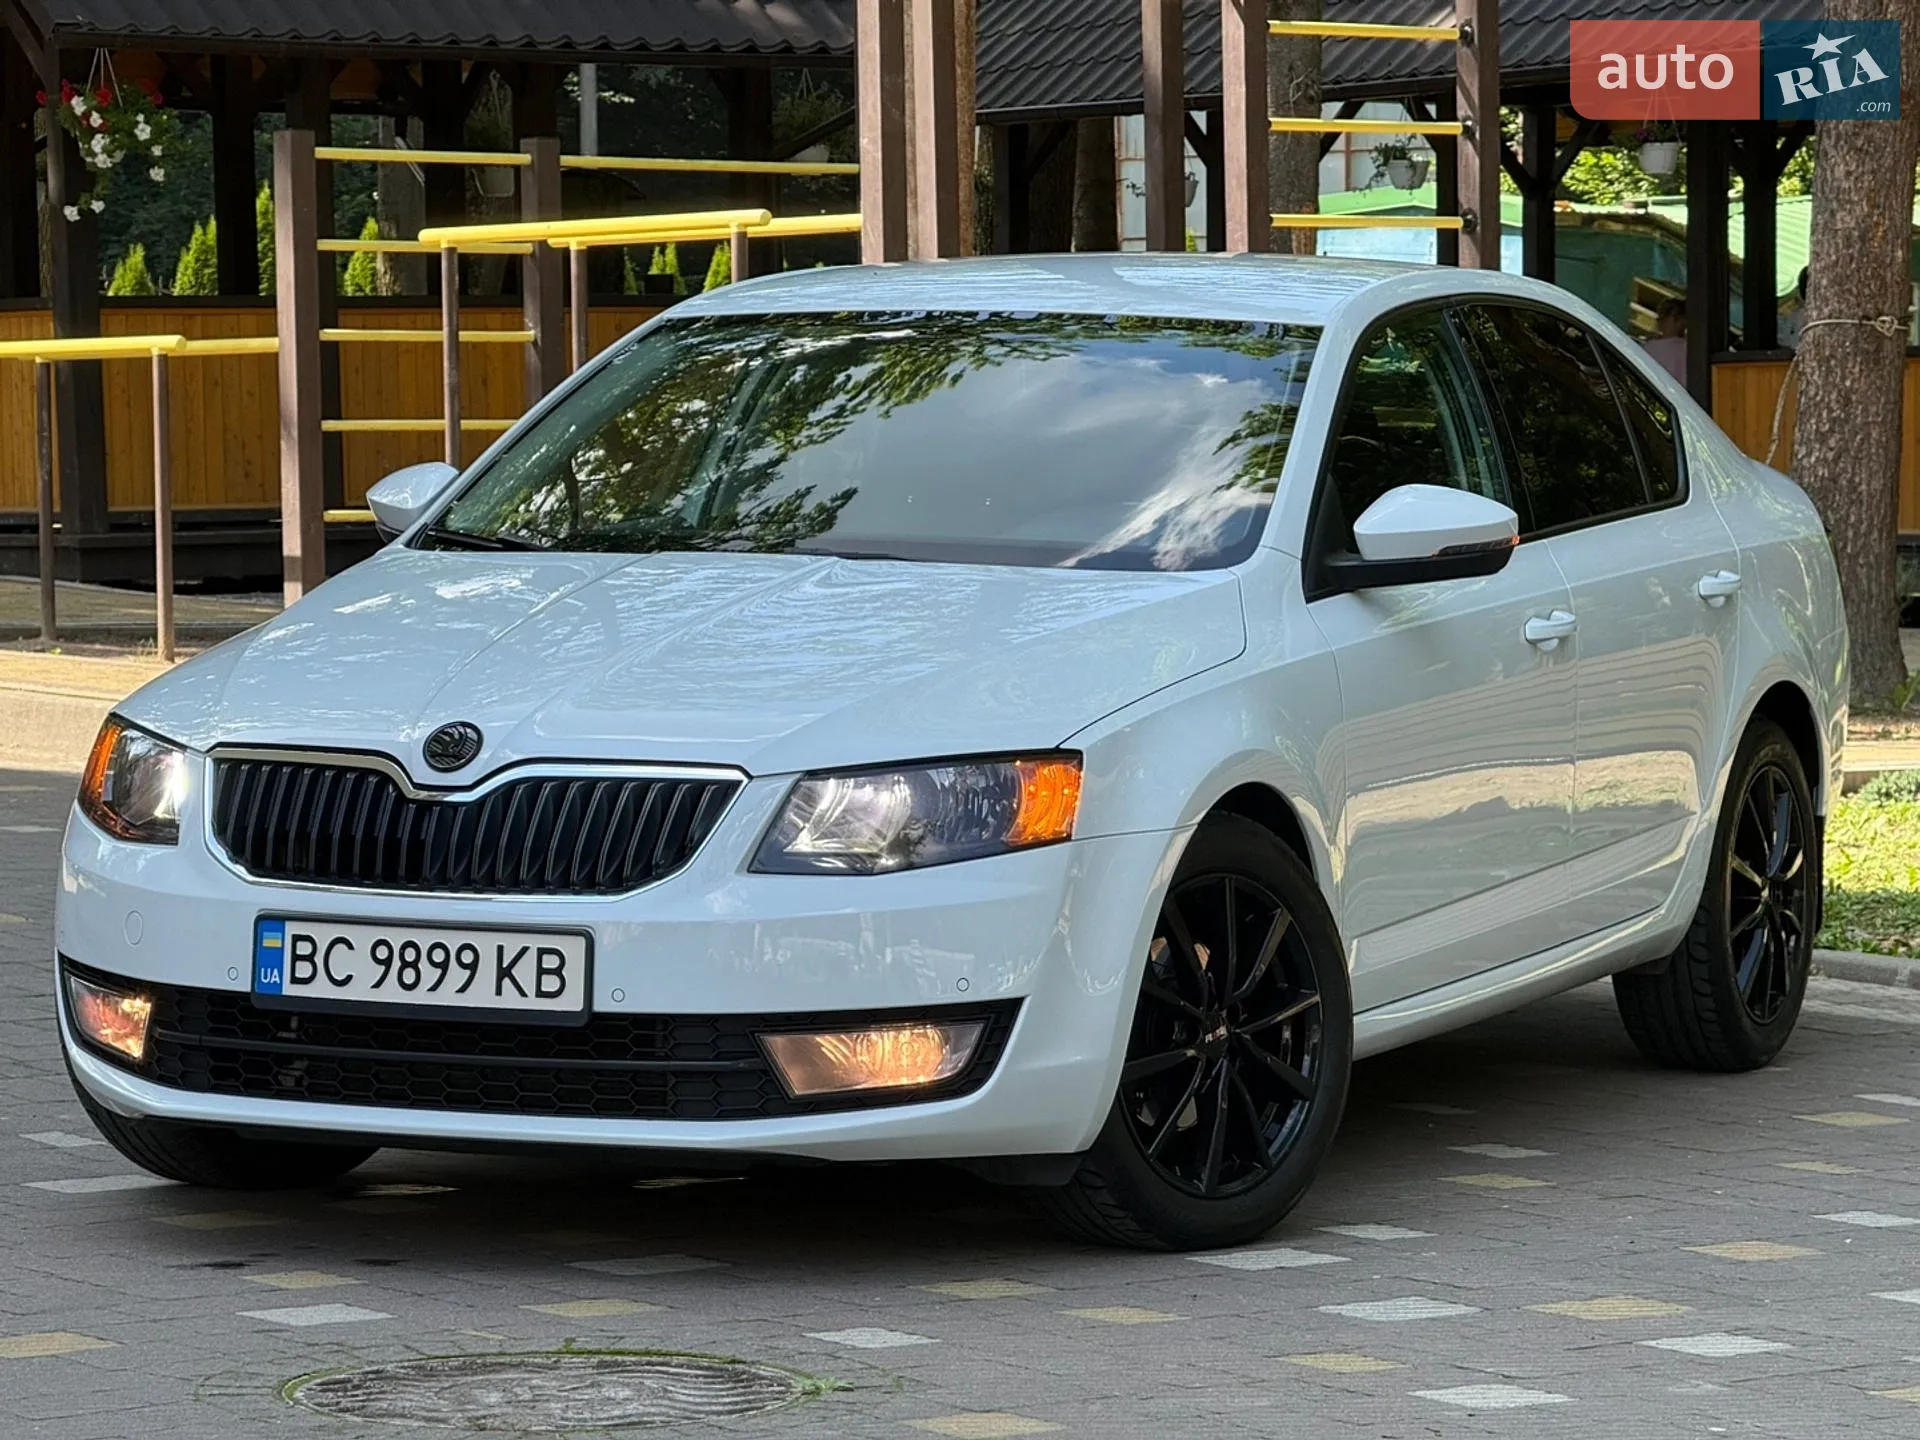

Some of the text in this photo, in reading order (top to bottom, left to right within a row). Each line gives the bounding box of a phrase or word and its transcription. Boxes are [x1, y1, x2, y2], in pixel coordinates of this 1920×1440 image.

[260, 970, 281, 985] UA
[289, 933, 567, 999] BC 9899 KB
